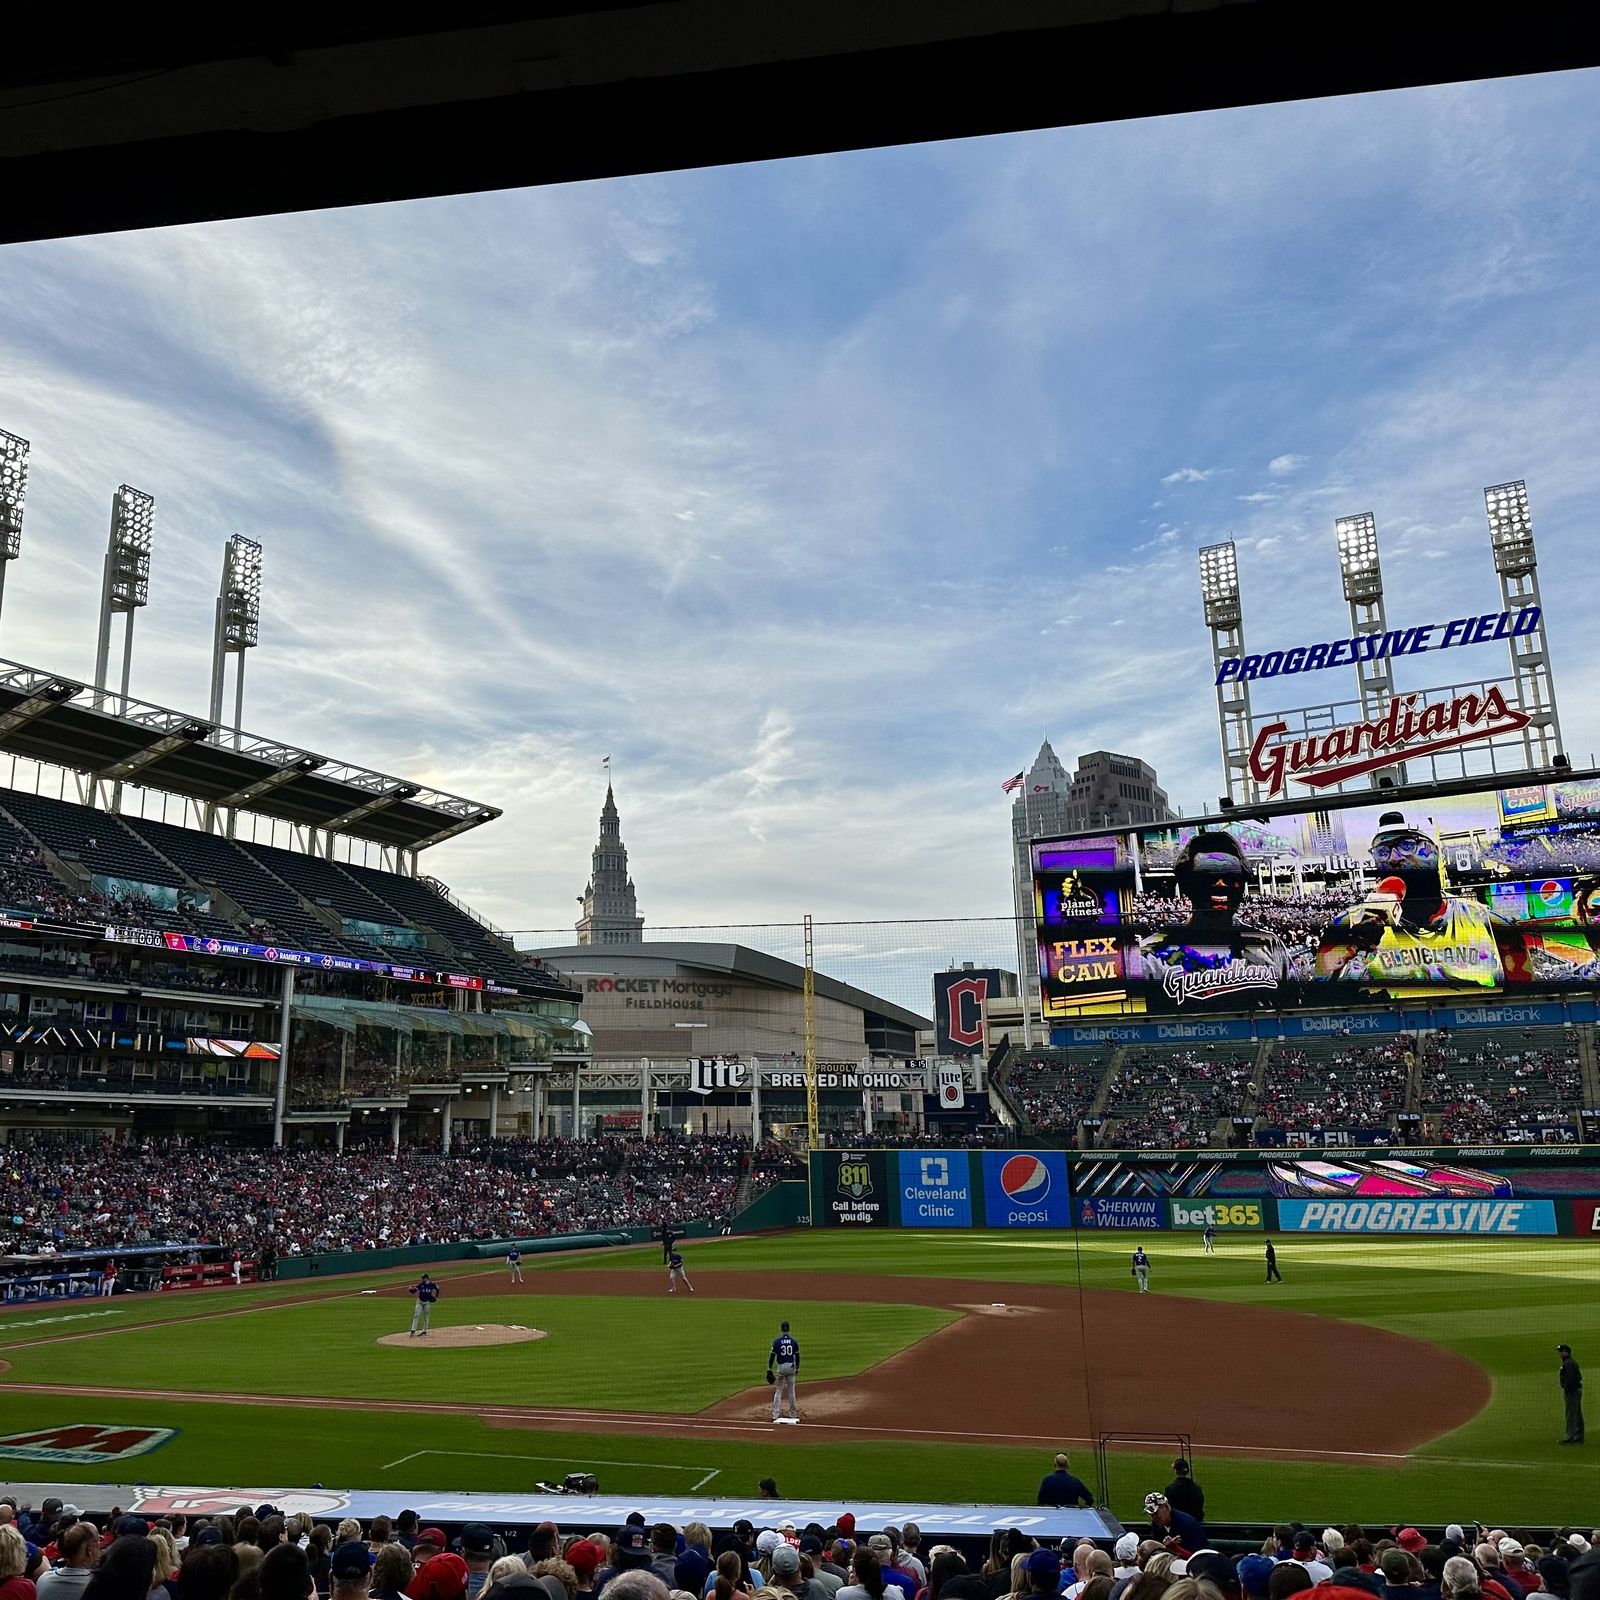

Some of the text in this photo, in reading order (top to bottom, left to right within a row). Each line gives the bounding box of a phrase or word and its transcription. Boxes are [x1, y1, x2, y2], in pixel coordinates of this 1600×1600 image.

[1214, 606, 1542, 687] PROGRESSIVE FIELD
[1248, 684, 1534, 800] Guardians
[1508, 796, 1540, 809] CAM
[1060, 898, 1096, 912] planet
[1065, 907, 1105, 917] fitness
[222, 945, 239, 954] KWAN
[242, 947, 250, 955] LF
[1052, 937, 1118, 960] FLEX
[436, 972, 443, 983] T
[1058, 961, 1118, 983] CAM
[587, 977, 733, 998] ROCKET Mortgage
[1163, 958, 1278, 1006] Guardians
[947, 977, 988, 1047] C
[1073, 1006, 1540, 1041] DollarBank DollarBank DollarBank DollarBank
[814, 1063, 857, 1073] PROUDLY
[687, 1057, 746, 1096] Lite
[771, 1073, 901, 1088] BREWED IN OHIO
[940, 1072, 961, 1086] Lite
[1286, 1132, 1318, 1147] Elk
[1506, 1129, 1536, 1142] Elk
[1138, 1152, 1177, 1160] PROGRESSIVE
[1258, 1151, 1303, 1159] PROGRESSIVE
[1322, 1150, 1367, 1158] PROGRESSIVE
[1388, 1149, 1435, 1157] PROGRESSIVE
[1530, 1148, 1581, 1156] PROGRESSIVE
[841, 1165, 869, 1186] 811
[905, 1187, 967, 1200] Cleveland
[832, 1201, 880, 1211] Call before
[918, 1204, 955, 1217] Clinic
[1097, 1199, 1156, 1213] SHERWIN
[796, 1216, 810, 1224] 325
[840, 1211, 873, 1223] you dig.
[1008, 1209, 1048, 1225] pepsi
[1172, 1204, 1260, 1226] bet365
[1299, 1201, 1525, 1232] PROGRESSIVE
[780, 1345, 793, 1356] 30
[416, 1502, 1048, 1527] PROGRESSIVE FIELD
